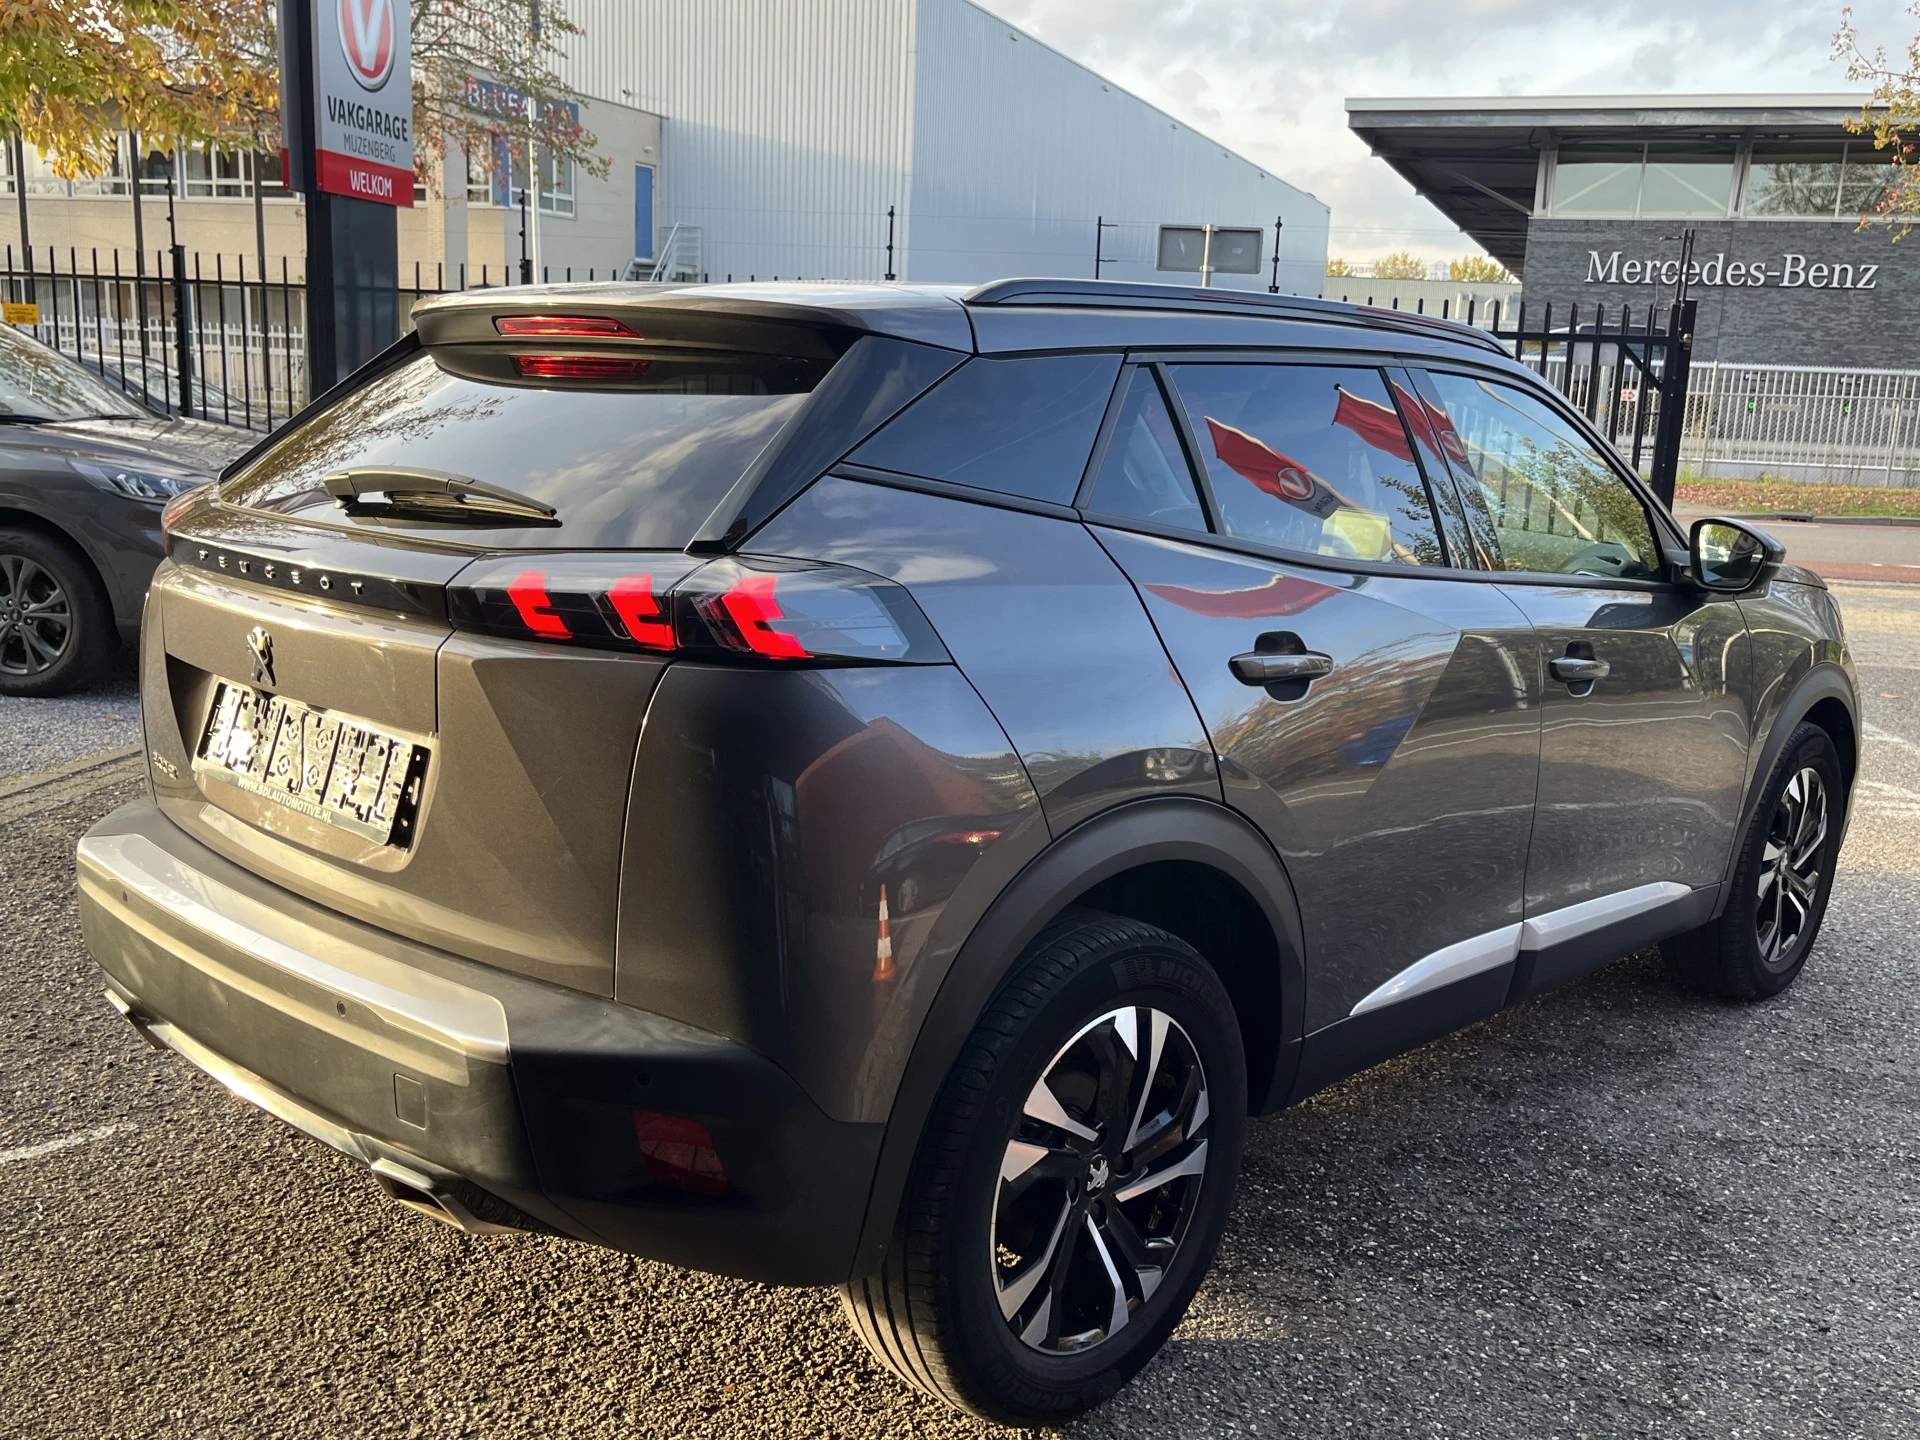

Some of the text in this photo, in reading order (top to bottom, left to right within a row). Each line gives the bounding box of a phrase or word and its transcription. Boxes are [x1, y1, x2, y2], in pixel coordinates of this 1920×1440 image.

[327, 95, 408, 142] VAKGARAGE
[343, 132, 396, 163] MUZENBERG
[350, 169, 393, 198] WELKOM
[1584, 250, 1879, 289] Mercedes-Benz
[199, 549, 365, 595] PEUGEOT
